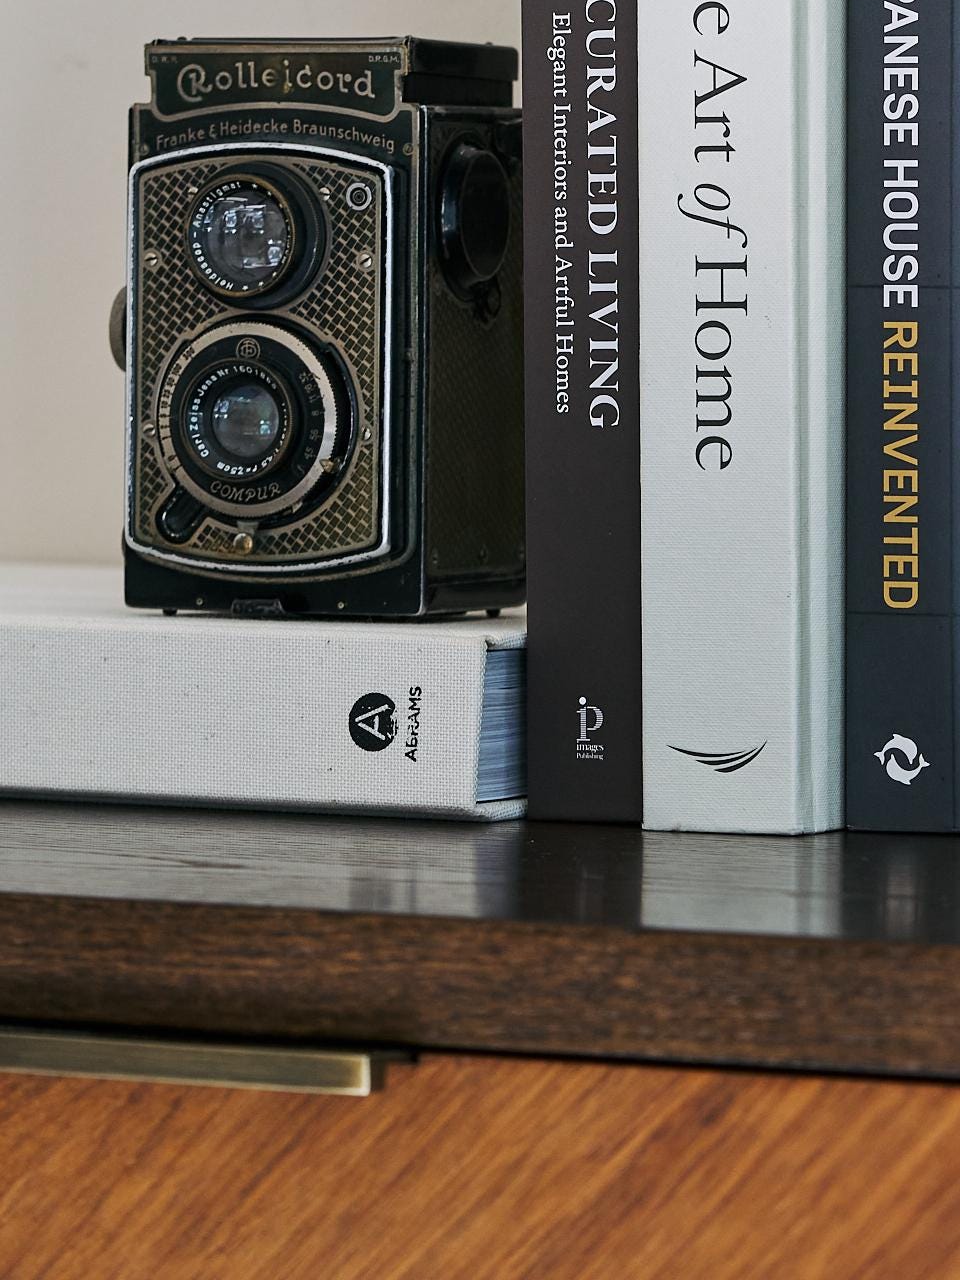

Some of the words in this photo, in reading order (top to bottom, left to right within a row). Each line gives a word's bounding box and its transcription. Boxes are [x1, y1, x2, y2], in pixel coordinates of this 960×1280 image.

[176, 59, 376, 103] Rolleicord
[547, 12, 572, 97] Elegant
[156, 128, 205, 150] Franke
[209, 124, 217, 140] &
[220, 119, 287, 137] Heidecke
[292, 120, 395, 154] Braunschweig
[693, 49, 748, 163] Art
[553, 103, 572, 200] Interiors
[554, 206, 574, 249] and
[677, 183, 748, 249] of
[882, 159, 919, 308] HOUSE
[555, 254, 575, 327] Artful
[555, 333, 574, 414] Homes
[588, 250, 620, 429] LIVING
[694, 254, 748, 471] Home
[189, 398, 201, 431] Zeiss
[197, 375, 218, 397] Jena
[191, 433, 210, 458] Carl
[883, 320, 919, 609] REINVENTED
[210, 480, 281, 501] COMPUR
